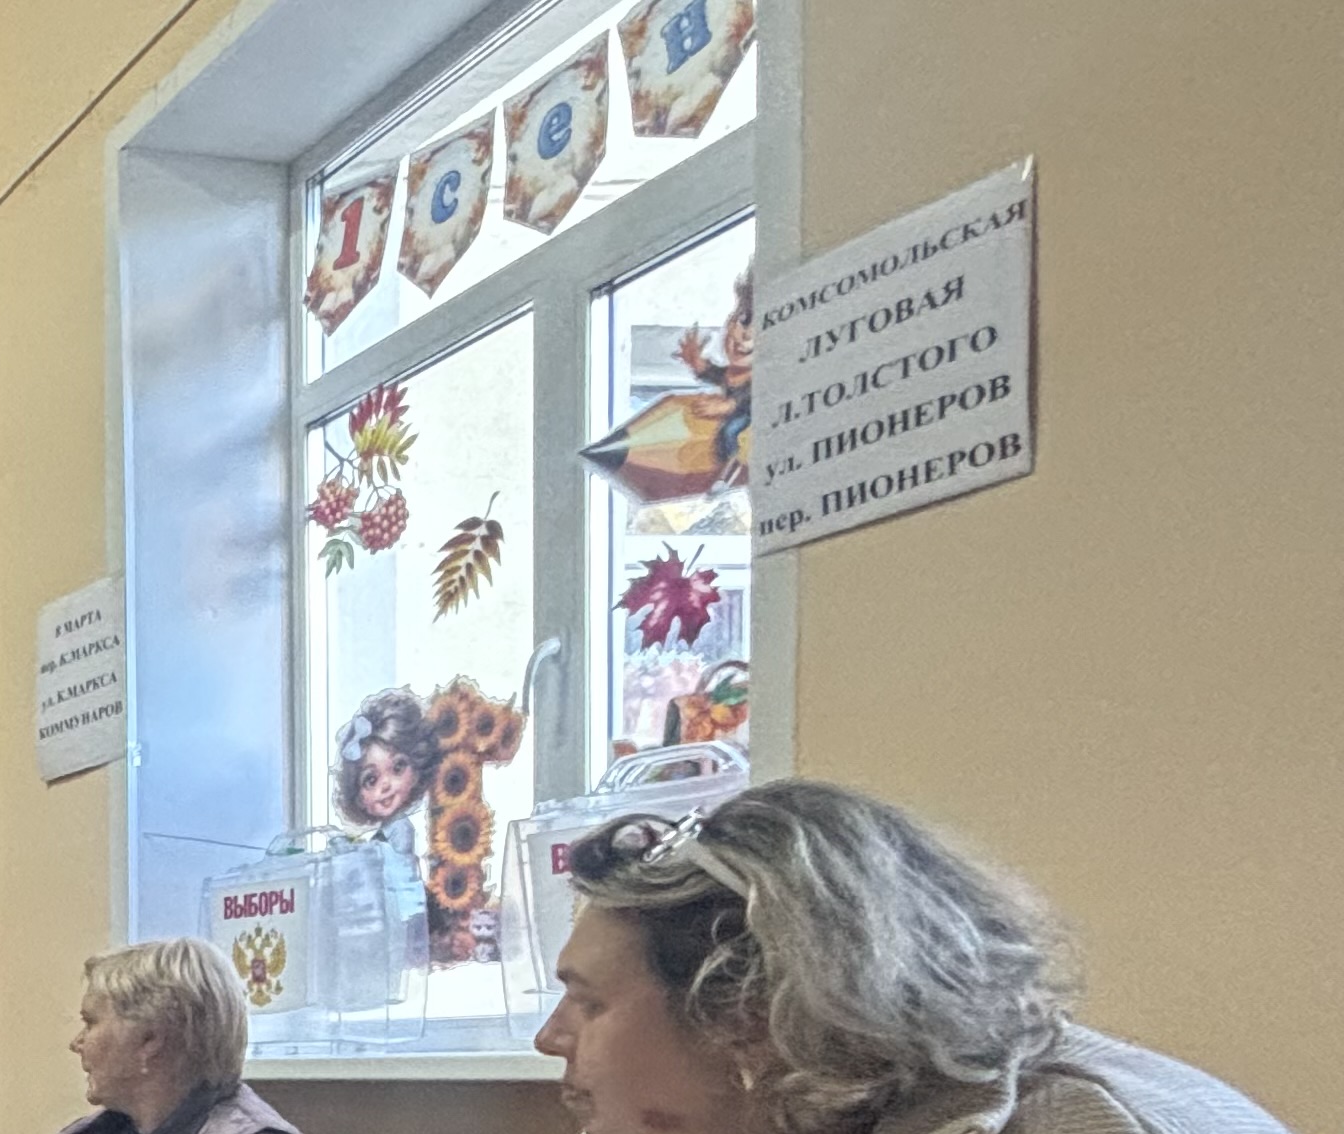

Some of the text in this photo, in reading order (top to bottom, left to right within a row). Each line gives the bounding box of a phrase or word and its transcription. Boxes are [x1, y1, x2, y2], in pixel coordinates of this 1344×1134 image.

[761, 197, 1029, 332] КОМСОМОЛЬСКАЯ
[798, 274, 967, 364] ЛУГОВАЯ
[770, 324, 999, 430] Л.ТОЛСТОГО
[763, 374, 1013, 487] ул. ПИОНЕРОВ
[758, 431, 1023, 538] пер. ПИОНЕРОВ
[63, 609, 102, 633] МАРТА
[38, 700, 124, 741] КОММУНАРОВ
[223, 887, 295, 921] ВЫБОРЫ
